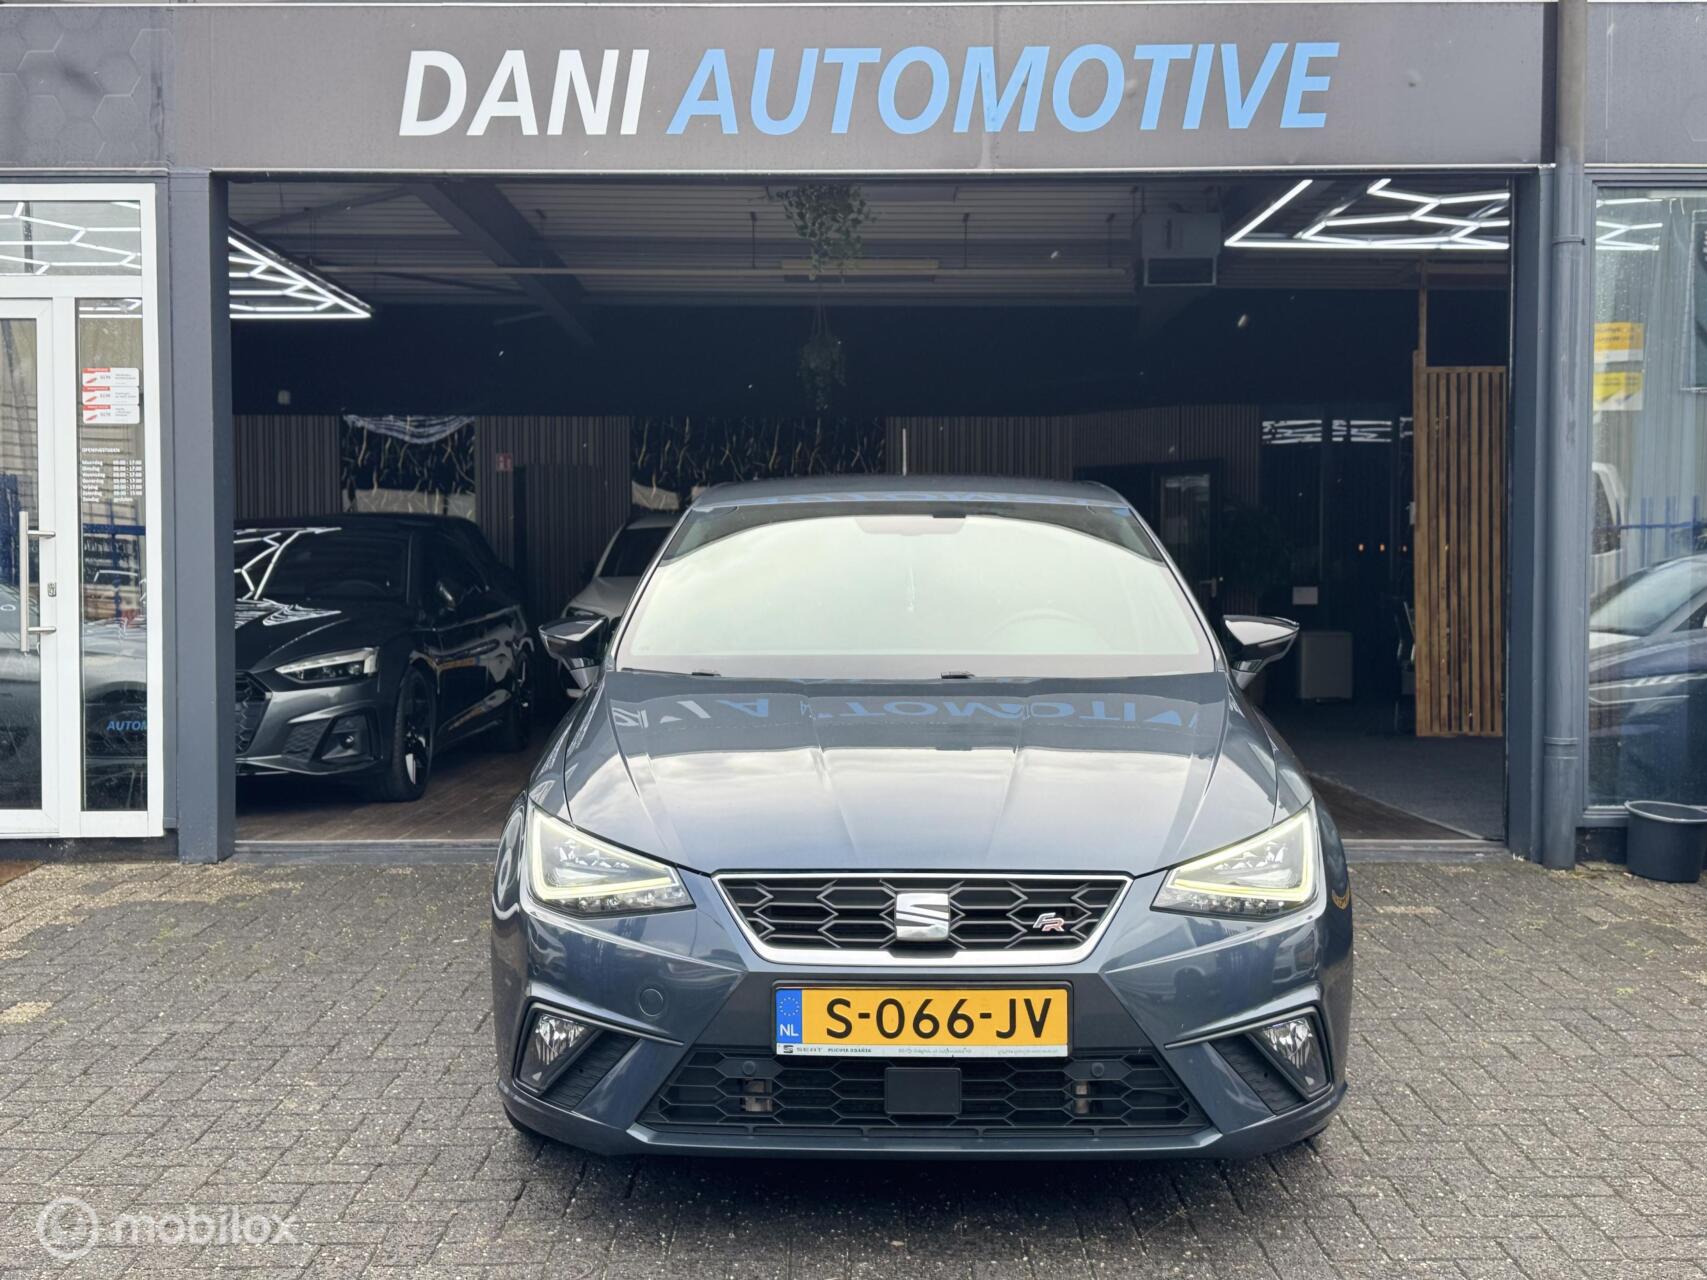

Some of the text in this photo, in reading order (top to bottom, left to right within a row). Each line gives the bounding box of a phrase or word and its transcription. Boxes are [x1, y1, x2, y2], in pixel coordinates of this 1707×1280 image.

[399, 41, 1339, 136] DANI AUTOMOTIVE
[780, 1024, 799, 1037] NL
[826, 998, 1052, 1039] S-066-JV
